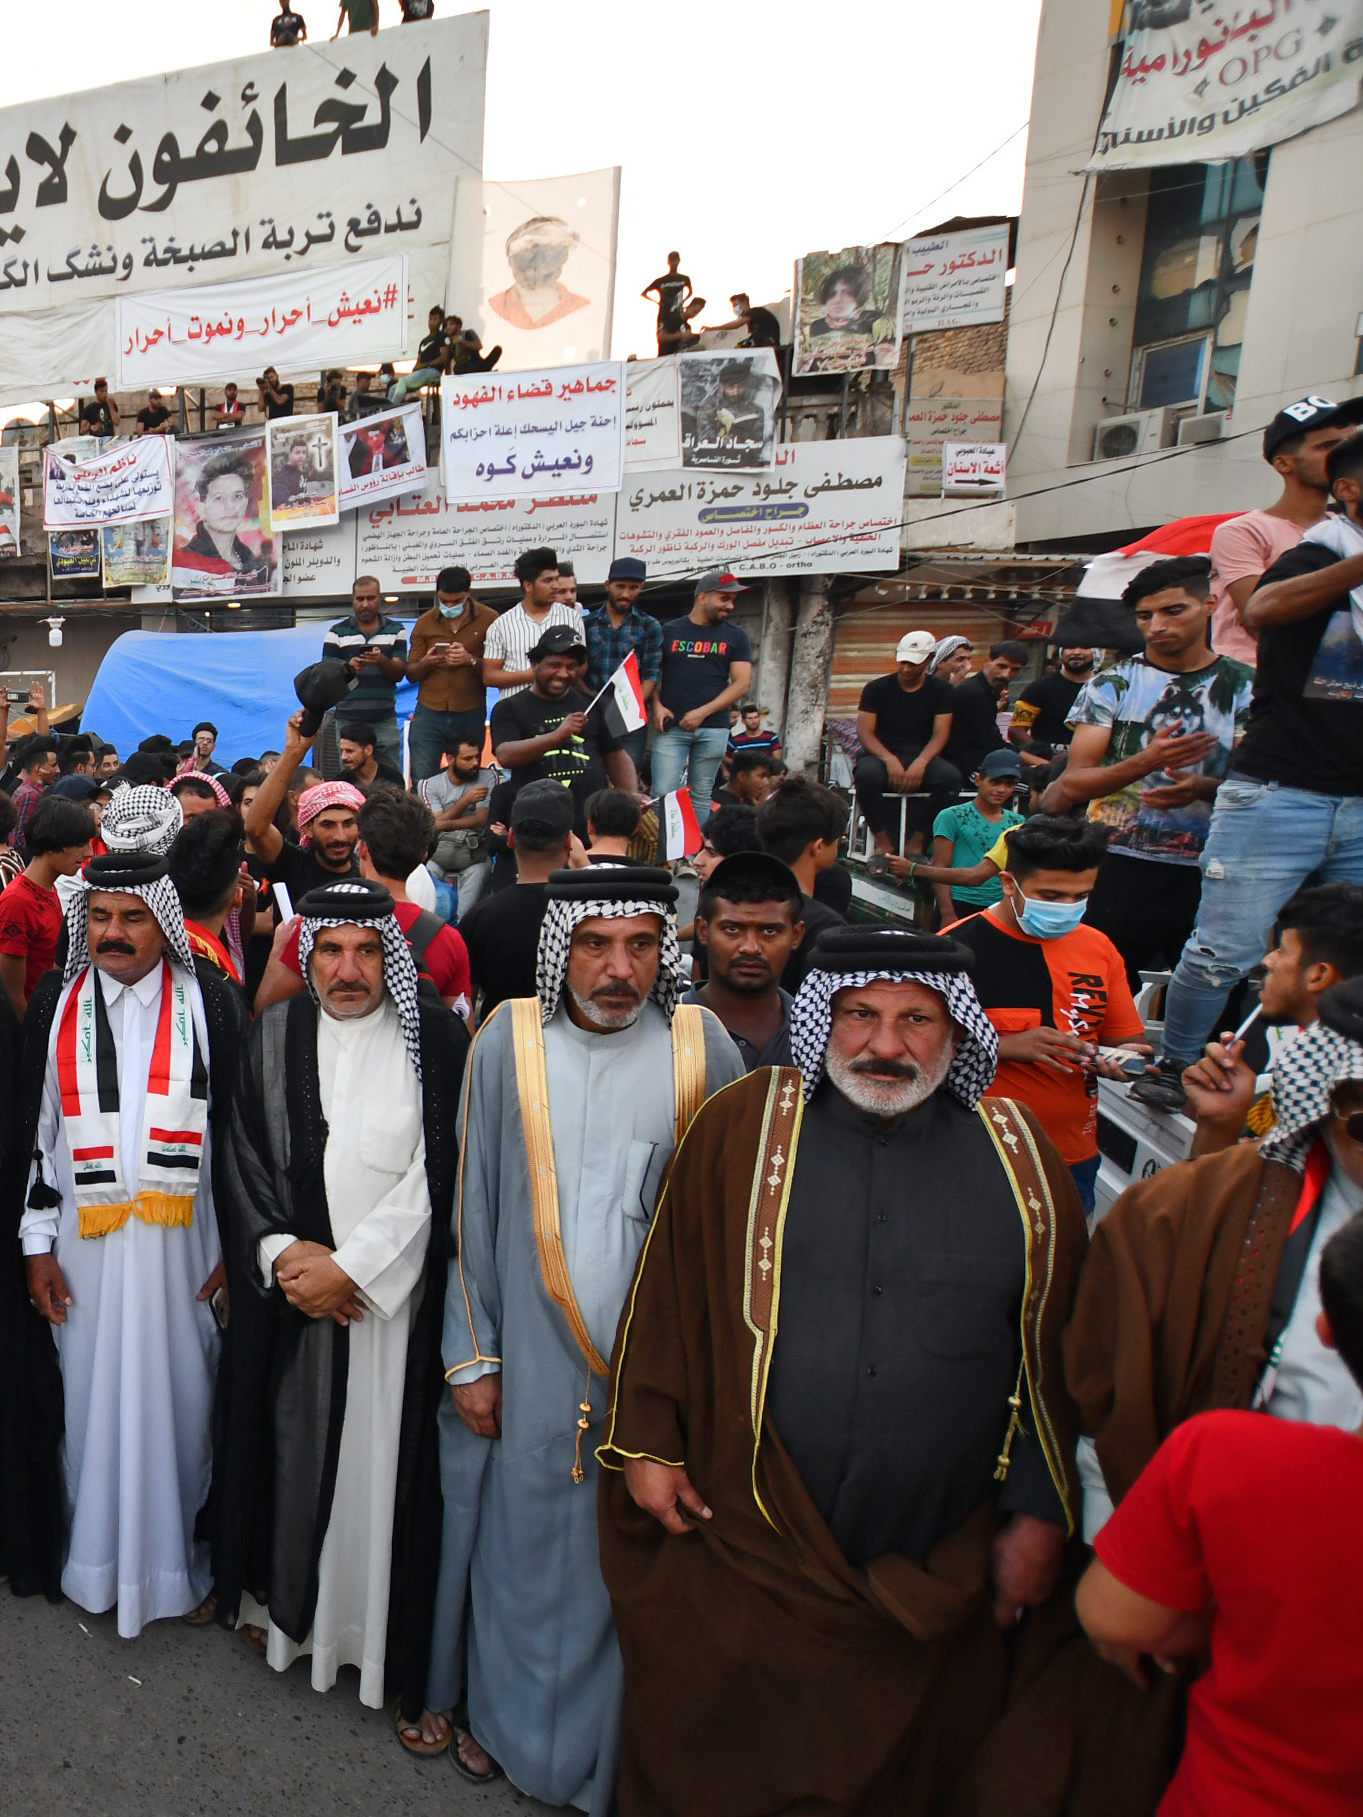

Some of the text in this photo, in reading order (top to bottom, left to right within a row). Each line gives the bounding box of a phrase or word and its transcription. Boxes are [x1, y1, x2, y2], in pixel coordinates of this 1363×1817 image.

[1218, 29, 1301, 86] OPG
[1223, 51, 1330, 125] الفكين
[98, 55, 432, 220] الخائفون
[343, 196, 423, 253] ندفع
[259, 209, 336, 262] تربة
[140, 225, 251, 273] الصبخة
[938, 248, 1003, 277] الدكتور
[453, 375, 617, 410] جماهير قضاء الفهود
[969, 411, 1000, 424] مصطفى
[519, 421, 563, 436] اليسحك
[564, 419, 588, 433] جيل
[449, 427, 492, 443] احزابكم
[728, 435, 764, 452] سجاد
[109, 453, 138, 475] ناظم
[521, 448, 594, 480] ونعيش
[629, 471, 883, 513] مصطفى جلود حمزة العمري
[368, 493, 449, 529] العتابي
[700, 504, 806, 523] جراح اختصاص
[546, 521, 568, 531] العربي
[589, 518, 609, 528] شهادة
[762, 522, 796, 535] والكسور
[798, 521, 827, 532] العظام
[829, 519, 856, 531] جراحة
[858, 516, 897, 530] اختصاص
[362, 532, 386, 542] الهضمي
[407, 529, 431, 538] وجراحة
[452, 526, 478, 535] الجراحة
[664, 528, 693, 542] الفقري
[695, 527, 724, 537] والعمود
[299, 538, 324, 552] شهادة
[586, 544, 608, 553] جراحة
[630, 544, 656, 556] الركبة
[684, 541, 715, 553] والركبة
[767, 537, 794, 549] تبديل
[402, 554, 421, 562] البطن
[785, 561, 813, 569] ortho
[297, 573, 317, 585] عضو
[671, 639, 728, 655] ESCOBAR
